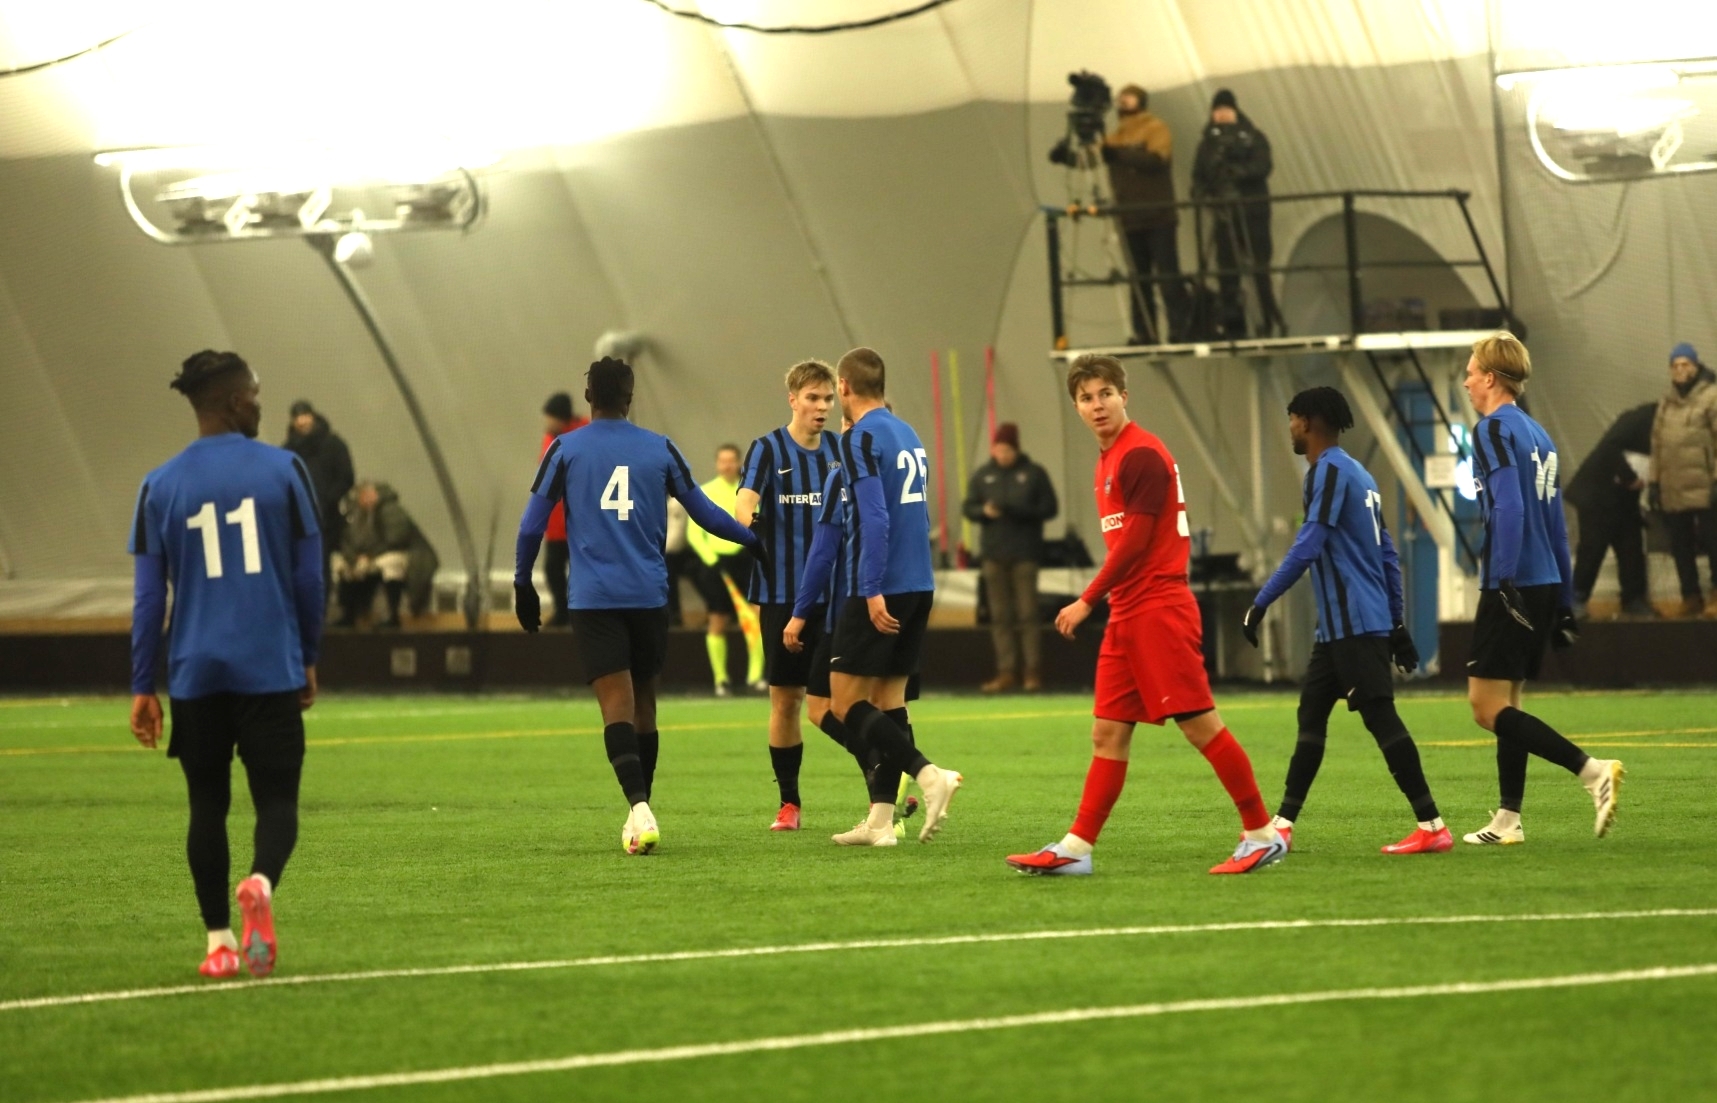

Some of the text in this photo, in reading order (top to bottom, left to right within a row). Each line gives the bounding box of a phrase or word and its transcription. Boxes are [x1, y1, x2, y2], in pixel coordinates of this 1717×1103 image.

[600, 465, 634, 521] 4
[897, 448, 927, 504] 25
[186, 497, 262, 579] 11
[1365, 489, 1381, 545] 17
